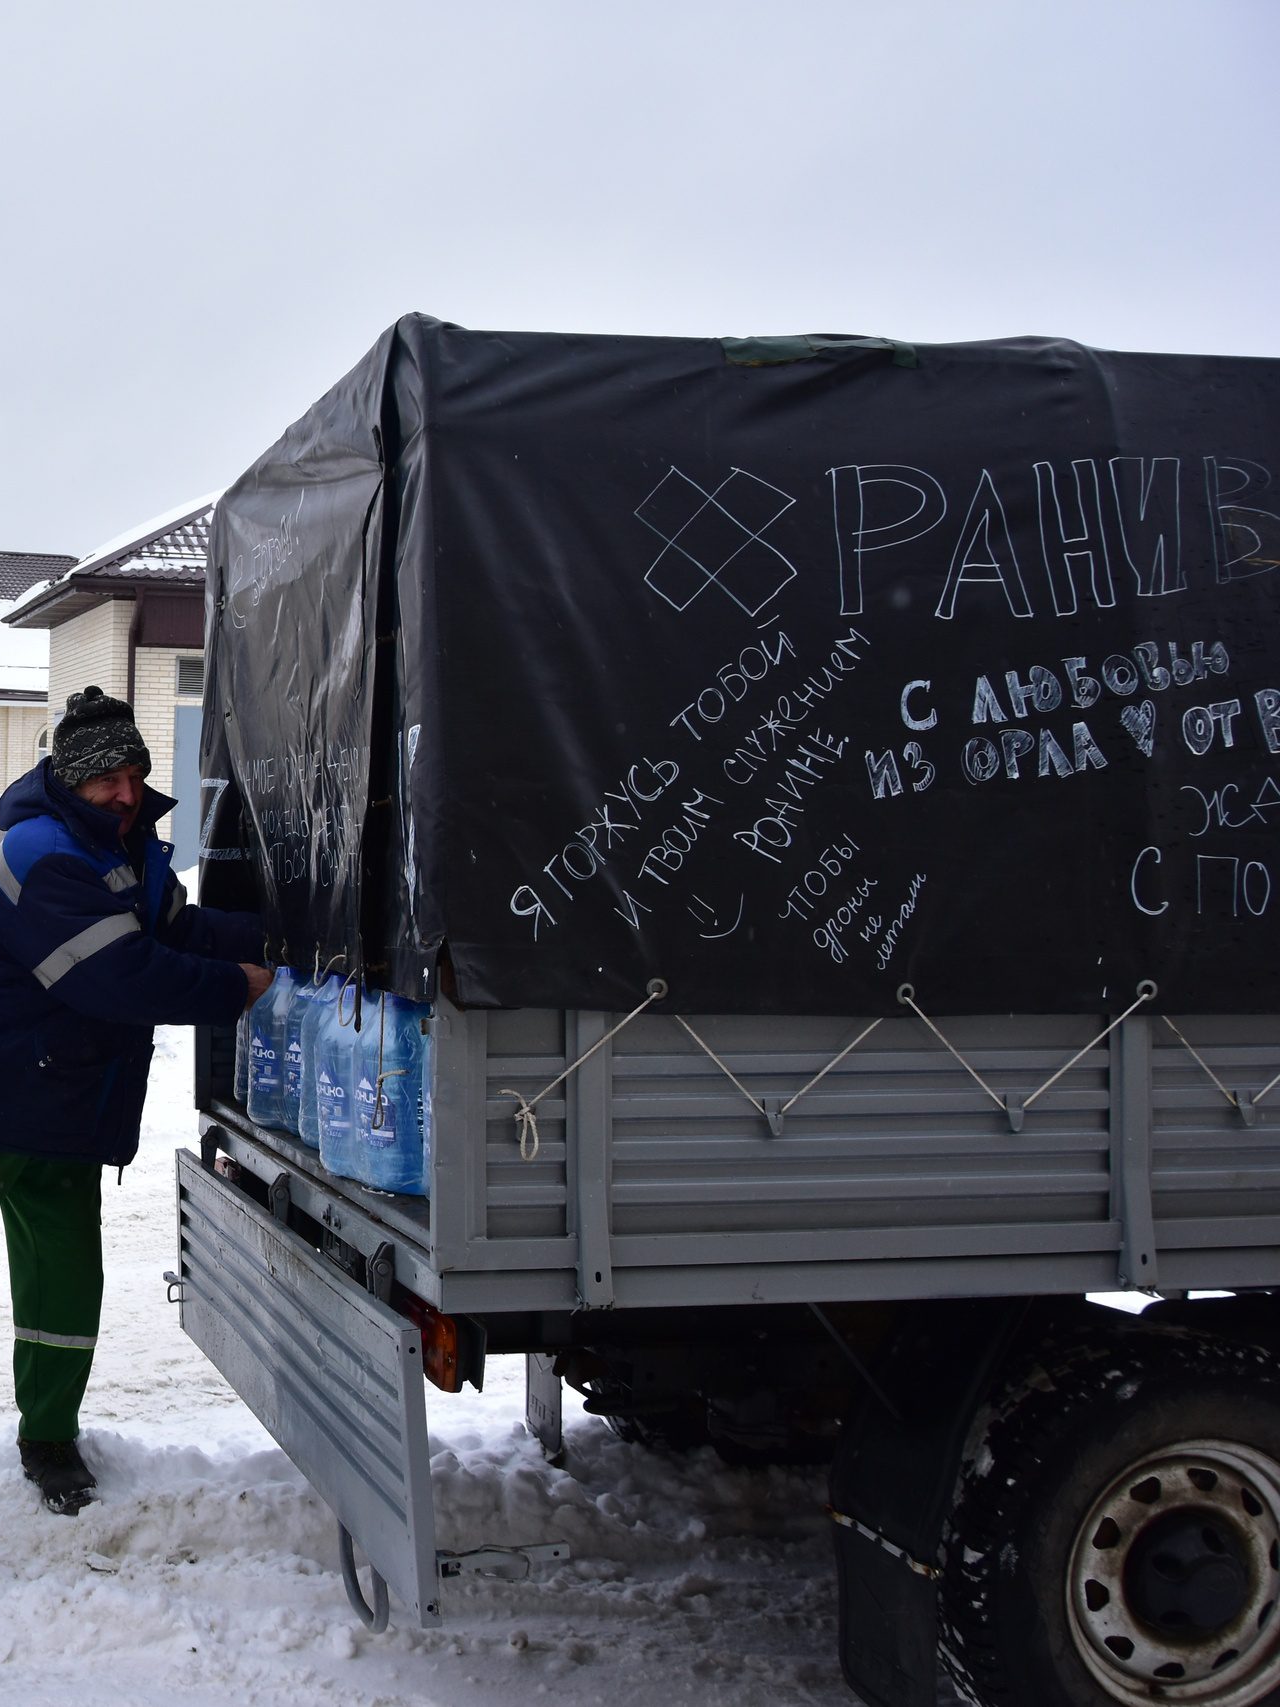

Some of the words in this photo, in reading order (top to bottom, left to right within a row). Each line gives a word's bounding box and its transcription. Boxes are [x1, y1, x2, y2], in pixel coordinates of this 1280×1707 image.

[899, 679, 939, 731] С
[970, 640, 1232, 725] ЛЮБОВЬЮ
[509, 883, 558, 942] Я
[542, 757, 681, 901] ГОРЖУСЬ
[668, 614, 799, 742] ТОБОЙ
[864, 741, 937, 800] ИЗ
[961, 721, 1109, 786] ОРЛА
[1181, 699, 1242, 756] ОТ
[613, 889, 653, 931] И
[637, 787, 725, 886] ТВОИМ
[778, 832, 861, 922] ЧТОБЫ
[1131, 846, 1169, 916] С
[812, 877, 878, 964] дроны
[859, 915, 883, 943] не
[877, 873, 928, 971] летали
